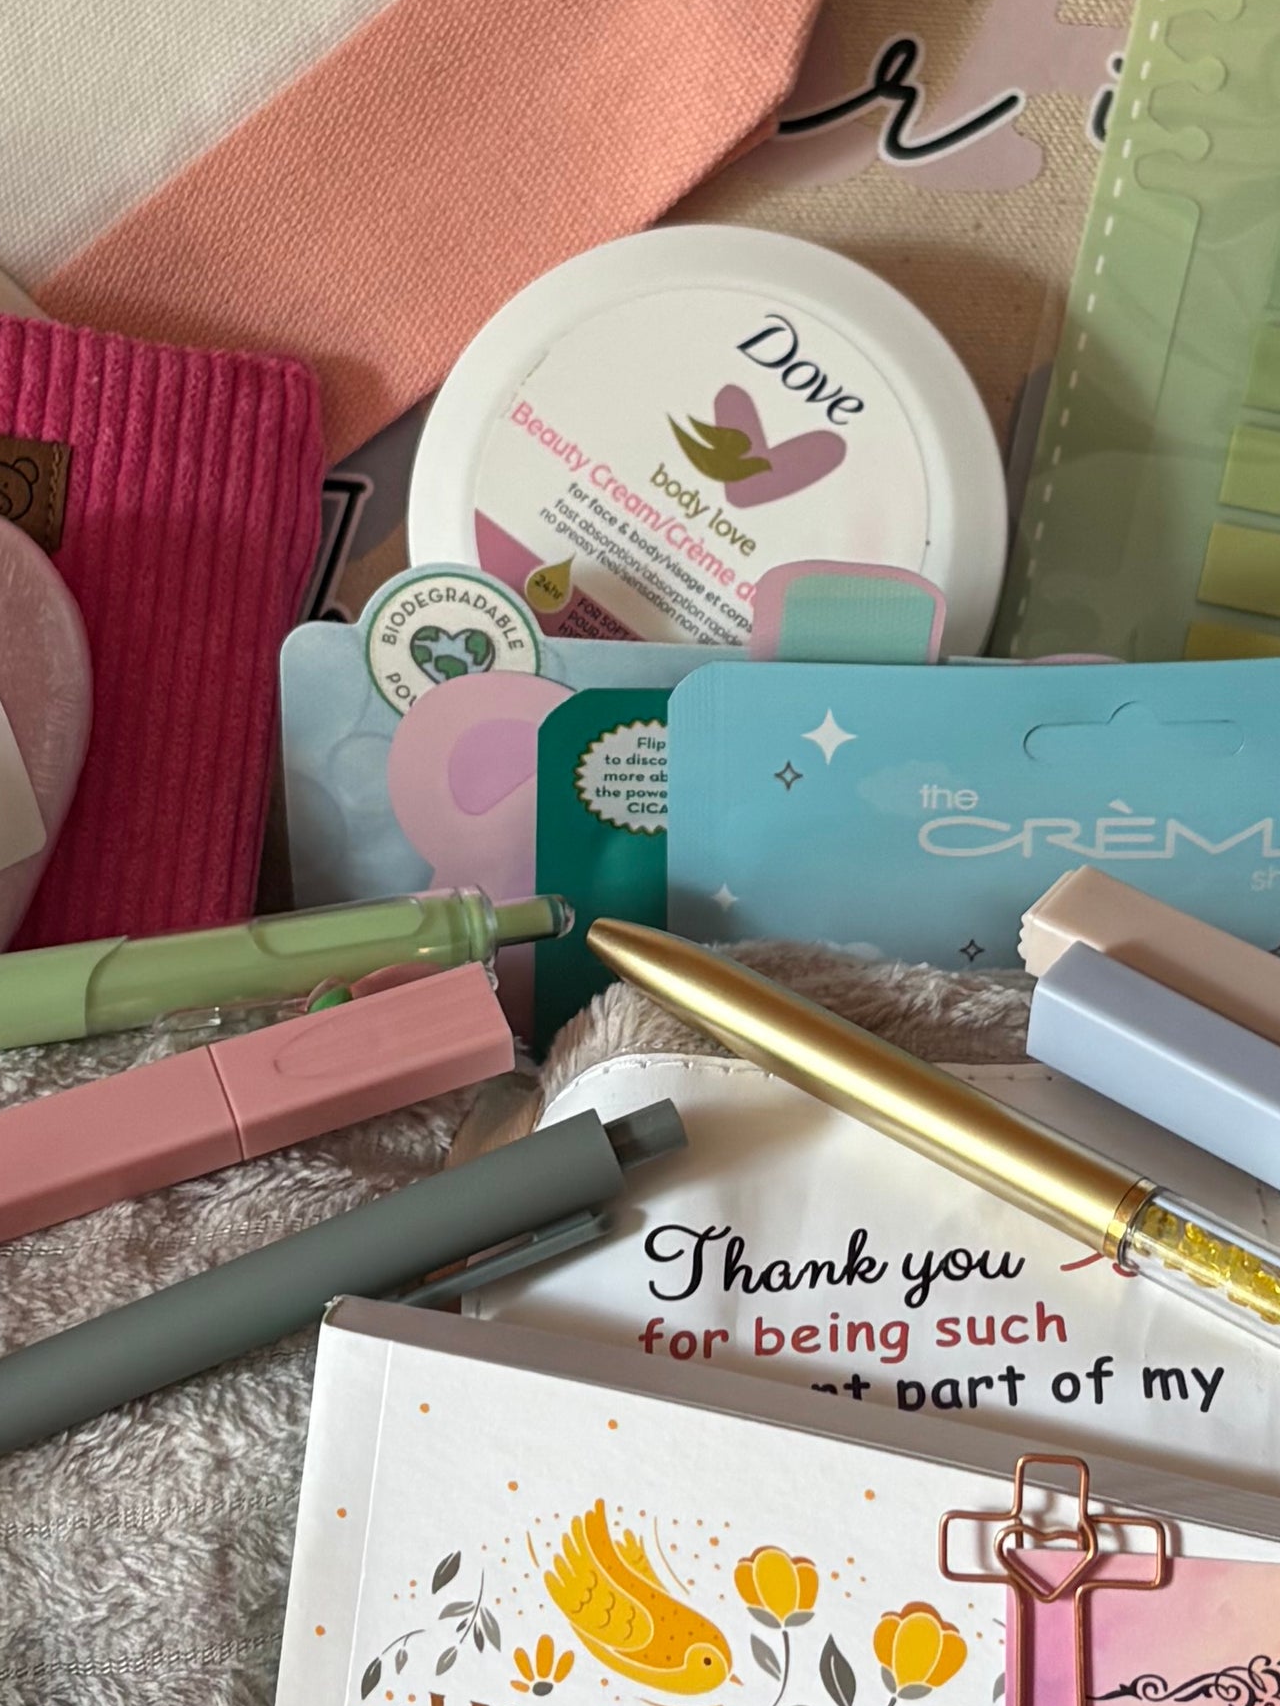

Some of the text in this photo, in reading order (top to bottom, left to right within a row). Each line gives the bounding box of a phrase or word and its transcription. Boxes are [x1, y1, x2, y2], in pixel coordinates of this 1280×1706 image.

[735, 314, 864, 425] Dove
[511, 401, 590, 472] Beauty
[588, 499, 618, 527] face
[650, 463, 756, 557] body love
[382, 587, 524, 650] BIODEGRADABLE
[605, 753, 668, 765] to disco
[637, 737, 666, 751] Flip
[595, 785, 668, 800] the powe
[604, 773, 645, 782] more
[920, 784, 979, 811] the
[643, 1224, 1025, 1309] Thank you
[638, 1301, 1067, 1364] for being such
[897, 1363, 1027, 1412] part
[1051, 1354, 1112, 1403] of
[1142, 1363, 1226, 1412] my
